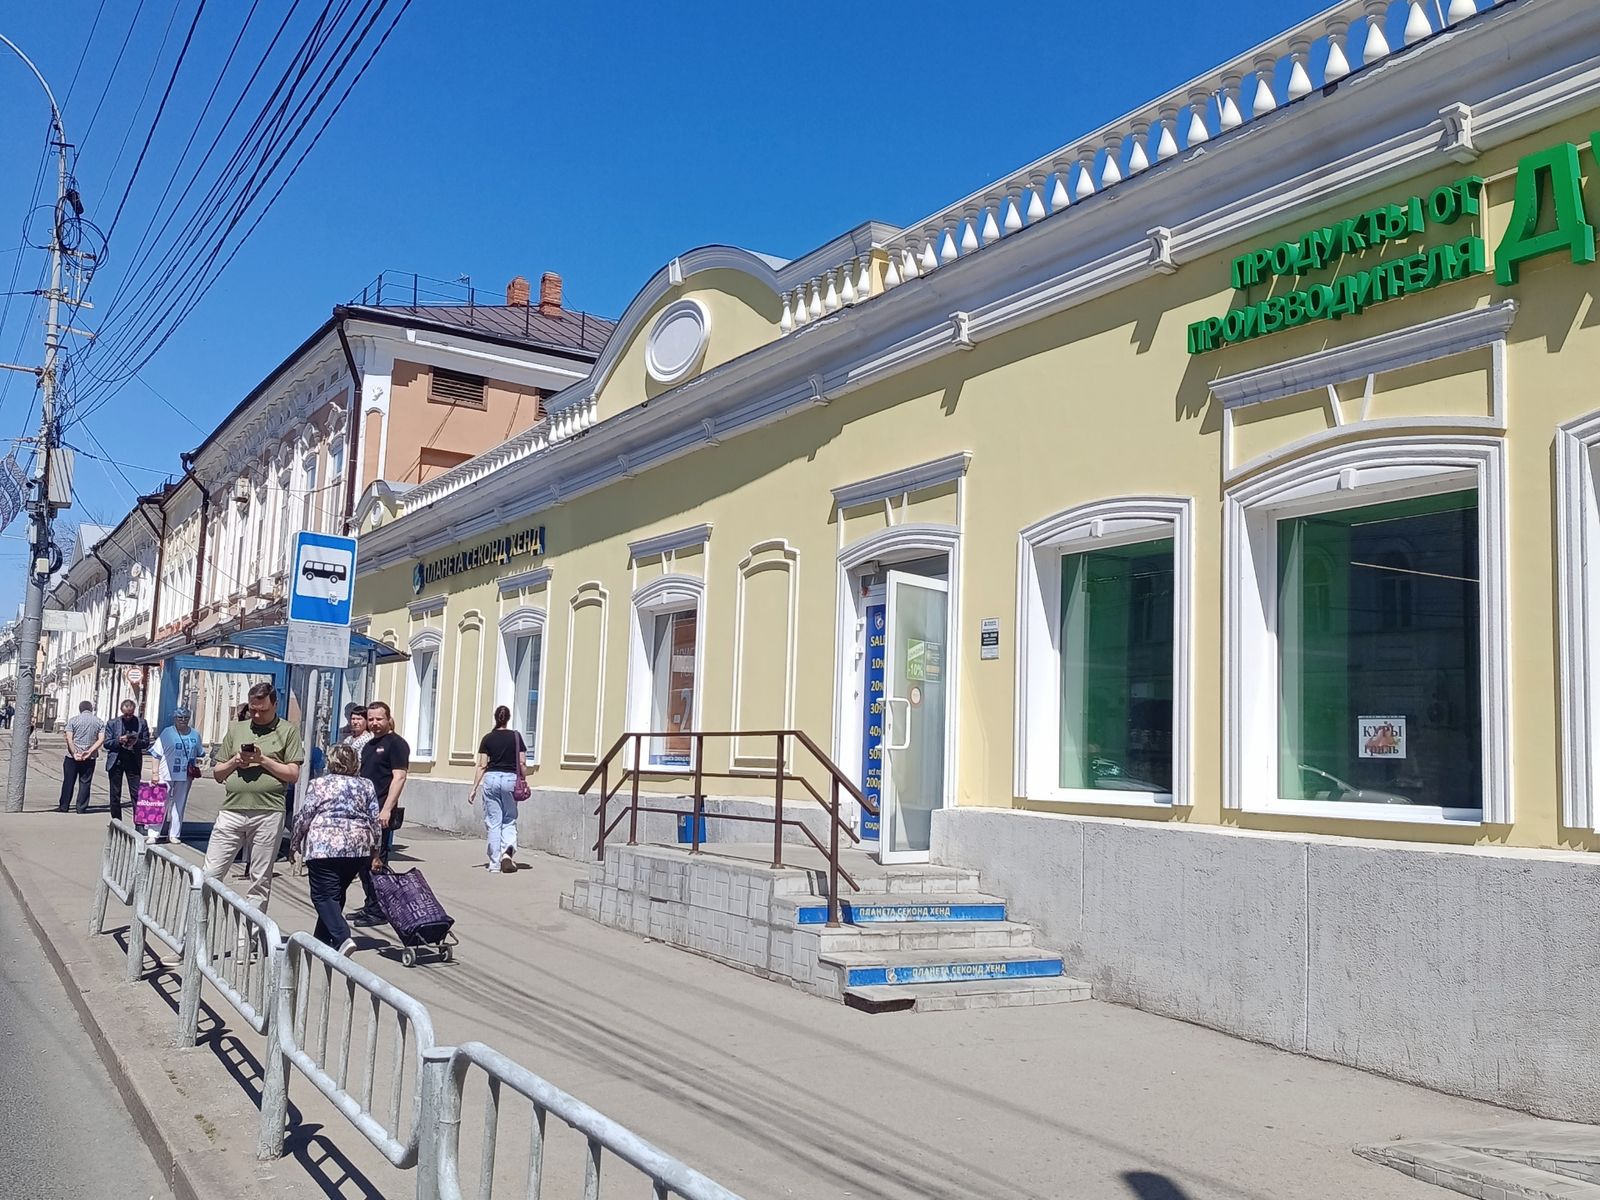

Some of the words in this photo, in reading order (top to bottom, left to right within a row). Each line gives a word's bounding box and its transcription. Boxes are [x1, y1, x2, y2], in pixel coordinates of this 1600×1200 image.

[1231, 195, 1425, 290] ПРОДУКТЫ
[1428, 175, 1485, 225] ОТ
[1495, 130, 1600, 286] Д
[1187, 235, 1485, 354] ПРОИЗВОДИТЕЛЯ
[425, 551, 464, 584] ПЛАНЕТА
[466, 537, 510, 570] СЕКОНД
[509, 527, 545, 558] ХЕНД
[1363, 725, 1403, 738] КУРЫ
[859, 906, 896, 917] ПЛАНЕТА
[897, 906, 929, 917] СЕКОНД
[929, 906, 951, 917] ХЕНД
[912, 966, 950, 977] ПЛАНЕТА
[951, 965, 983, 976] СЕКОНД
[985, 963, 1007, 975] ХЕНД
